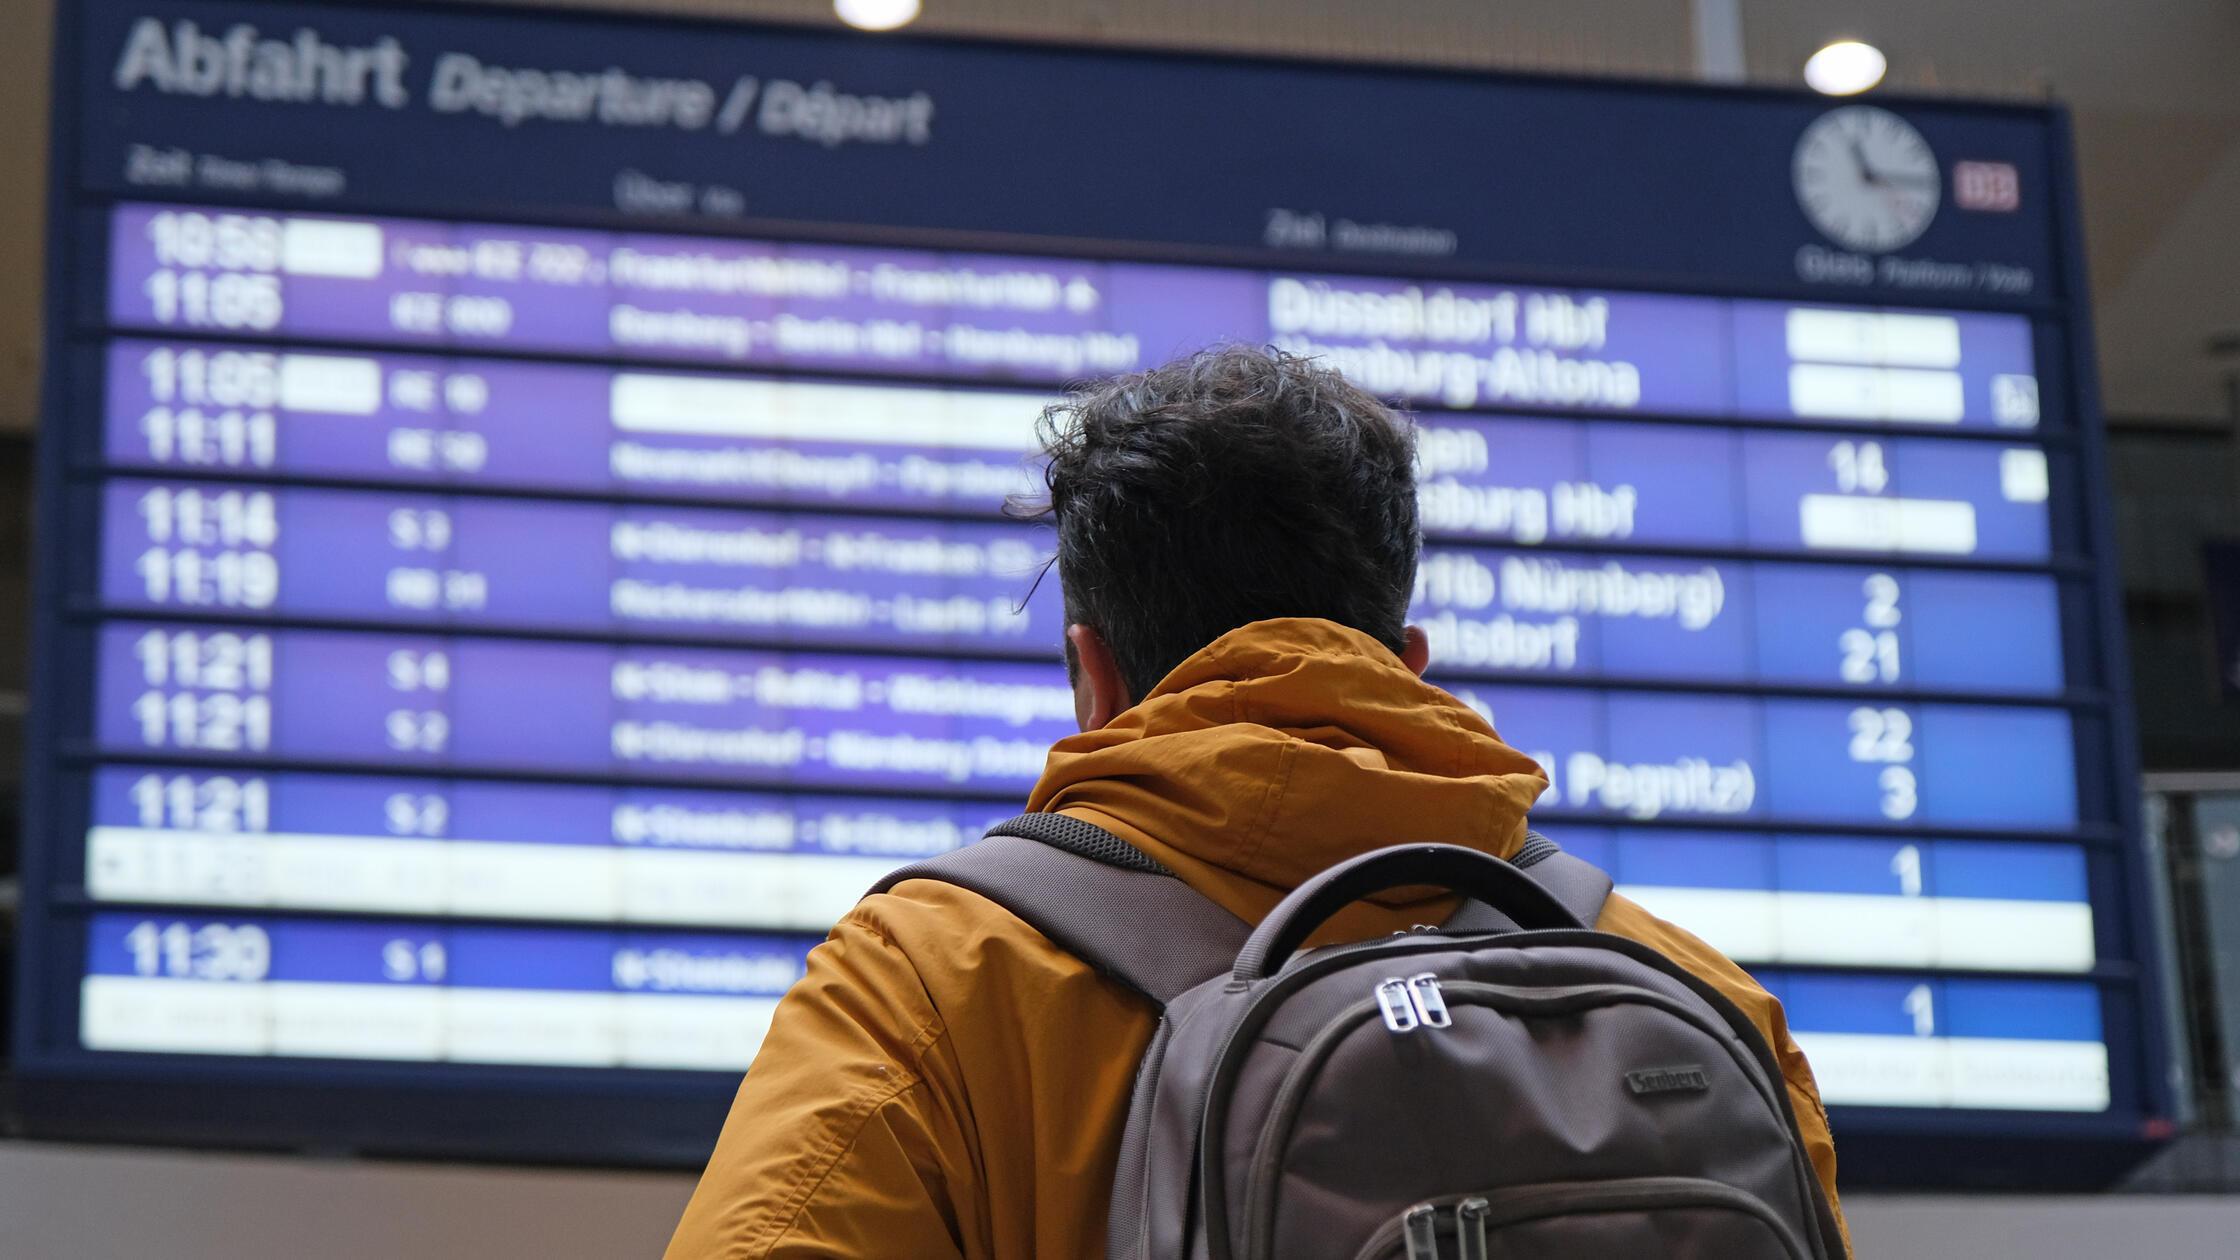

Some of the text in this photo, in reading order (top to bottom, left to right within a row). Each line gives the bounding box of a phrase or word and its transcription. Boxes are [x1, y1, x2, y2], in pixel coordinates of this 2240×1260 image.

[115, 17, 934, 147] Abfahrt Departure / Départ
[146, 268, 282, 330] 11:05
[1269, 277, 1608, 349] Düsseldorf Hbf
[143, 347, 279, 409] 11:05
[1275, 335, 1641, 408] mburg-Altona
[141, 405, 276, 469] 11:11
[1828, 440, 1889, 494] 14
[138, 486, 278, 548] 11:14
[1552, 480, 1636, 539] Hbf
[137, 546, 279, 609] 11:19
[1501, 556, 1725, 631] Nürnberg)
[1863, 573, 1901, 628] 2
[135, 628, 272, 692] 11:21
[1839, 628, 1900, 684] 21
[132, 689, 272, 751] 11:21
[1847, 706, 1914, 763] 22
[128, 773, 269, 833] 11:21
[1566, 752, 1755, 820] Pegnitz)
[1879, 765, 1917, 820] 3
[1890, 844, 1922, 897] 1
[123, 920, 271, 983] 11:30
[1904, 984, 1934, 1038] 1
